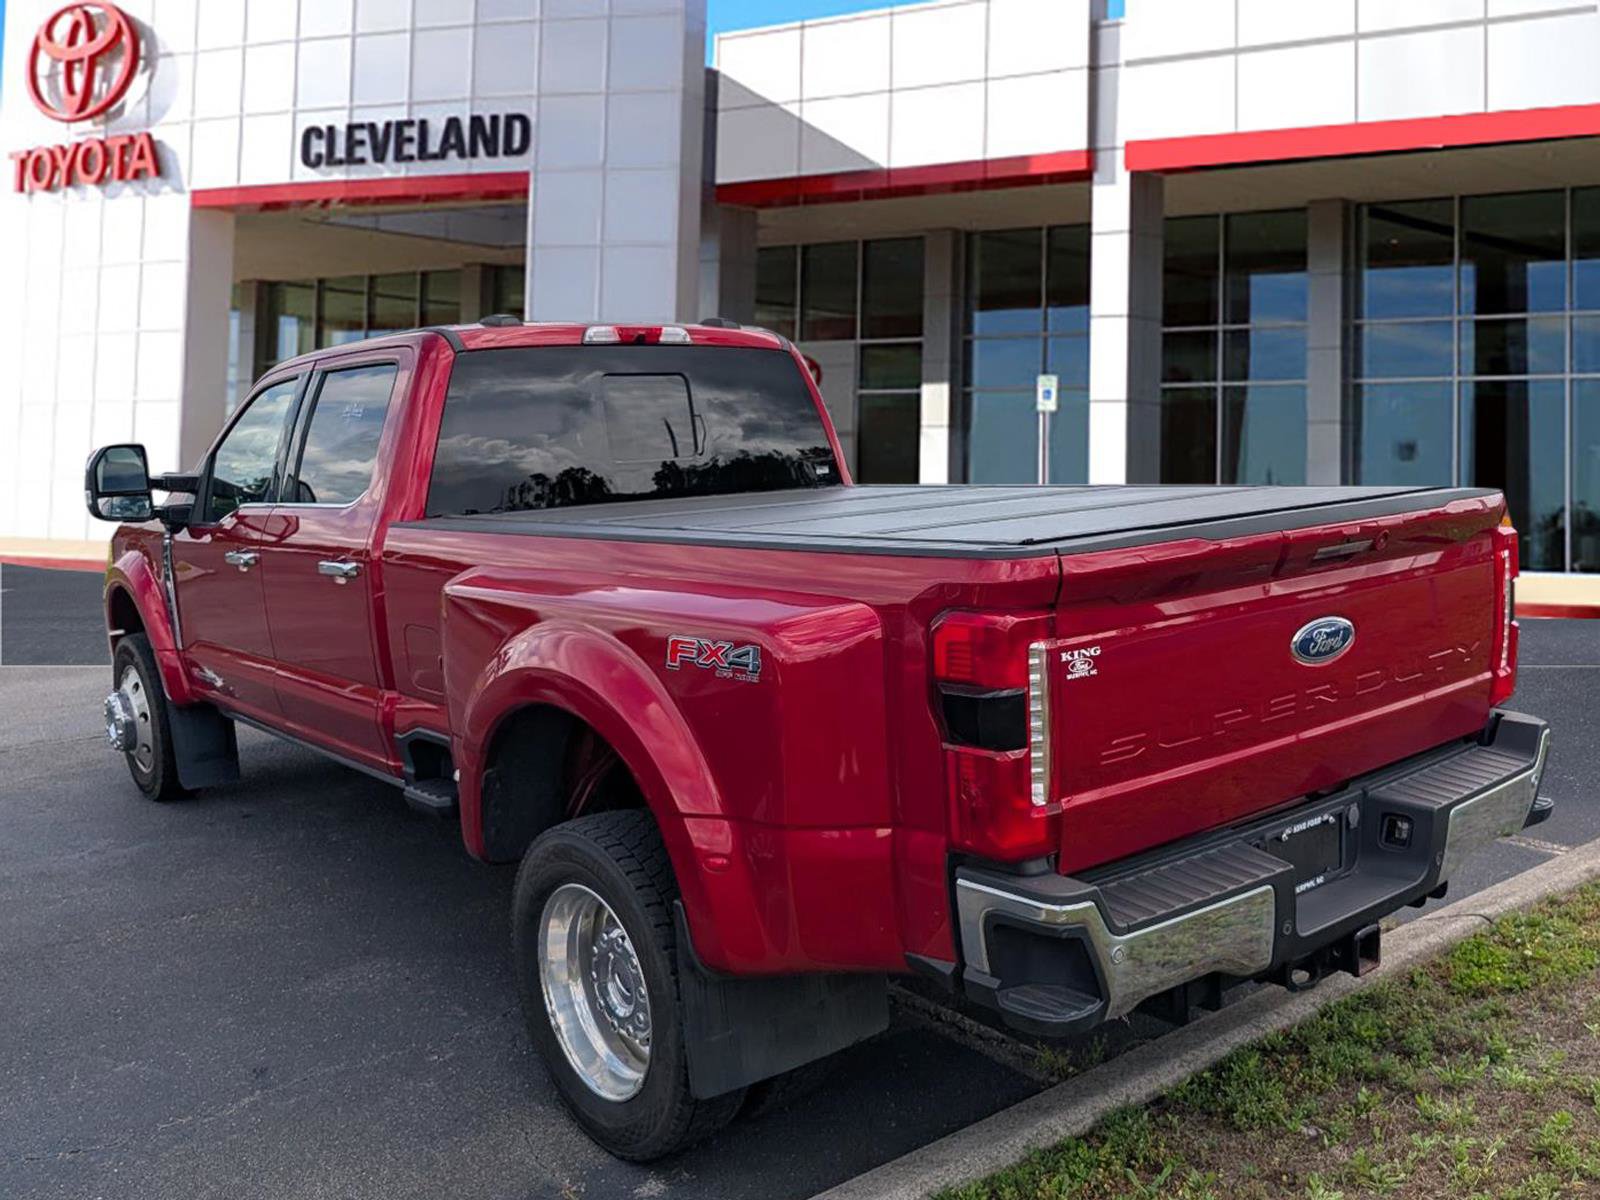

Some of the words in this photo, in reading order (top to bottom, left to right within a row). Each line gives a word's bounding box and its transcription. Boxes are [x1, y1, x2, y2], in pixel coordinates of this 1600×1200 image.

[300, 112, 532, 170] CLEVELAND
[9, 131, 161, 193] TOYOTA
[666, 635, 761, 675] FX4
[1060, 646, 1102, 662] KING
[1309, 627, 1344, 655] Ford
